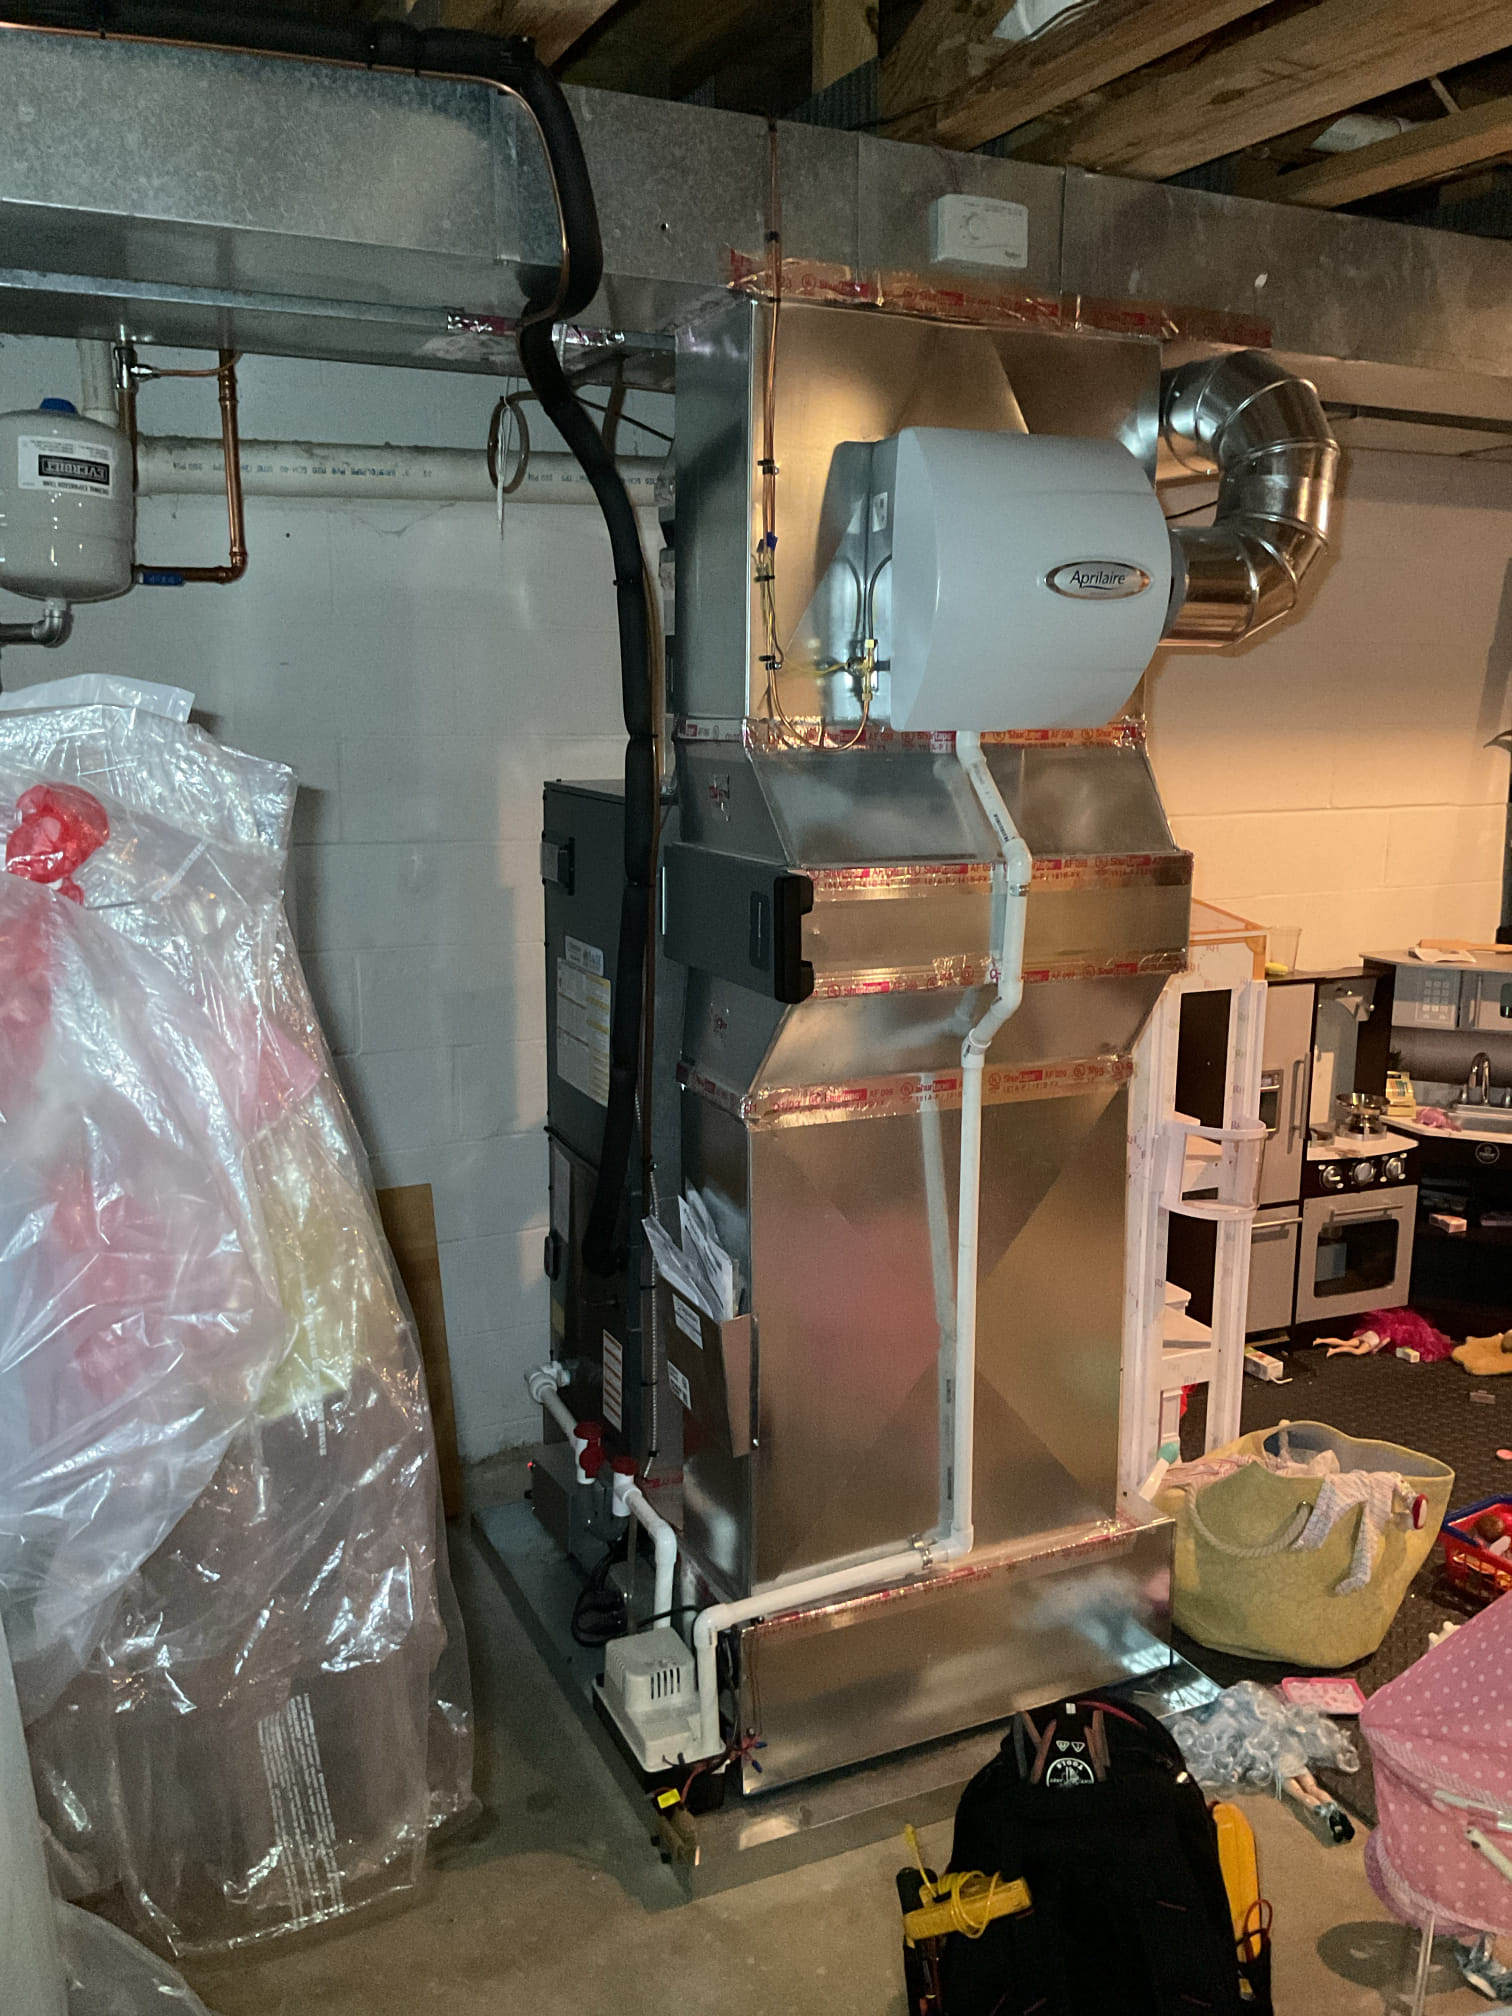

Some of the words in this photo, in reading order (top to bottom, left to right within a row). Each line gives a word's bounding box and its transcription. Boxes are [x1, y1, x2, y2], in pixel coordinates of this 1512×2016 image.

[45, 461, 105, 481] EVERBILT
[1069, 569, 1126, 588] Aprilaire
[1056, 1760, 1084, 1771] TOOLS
